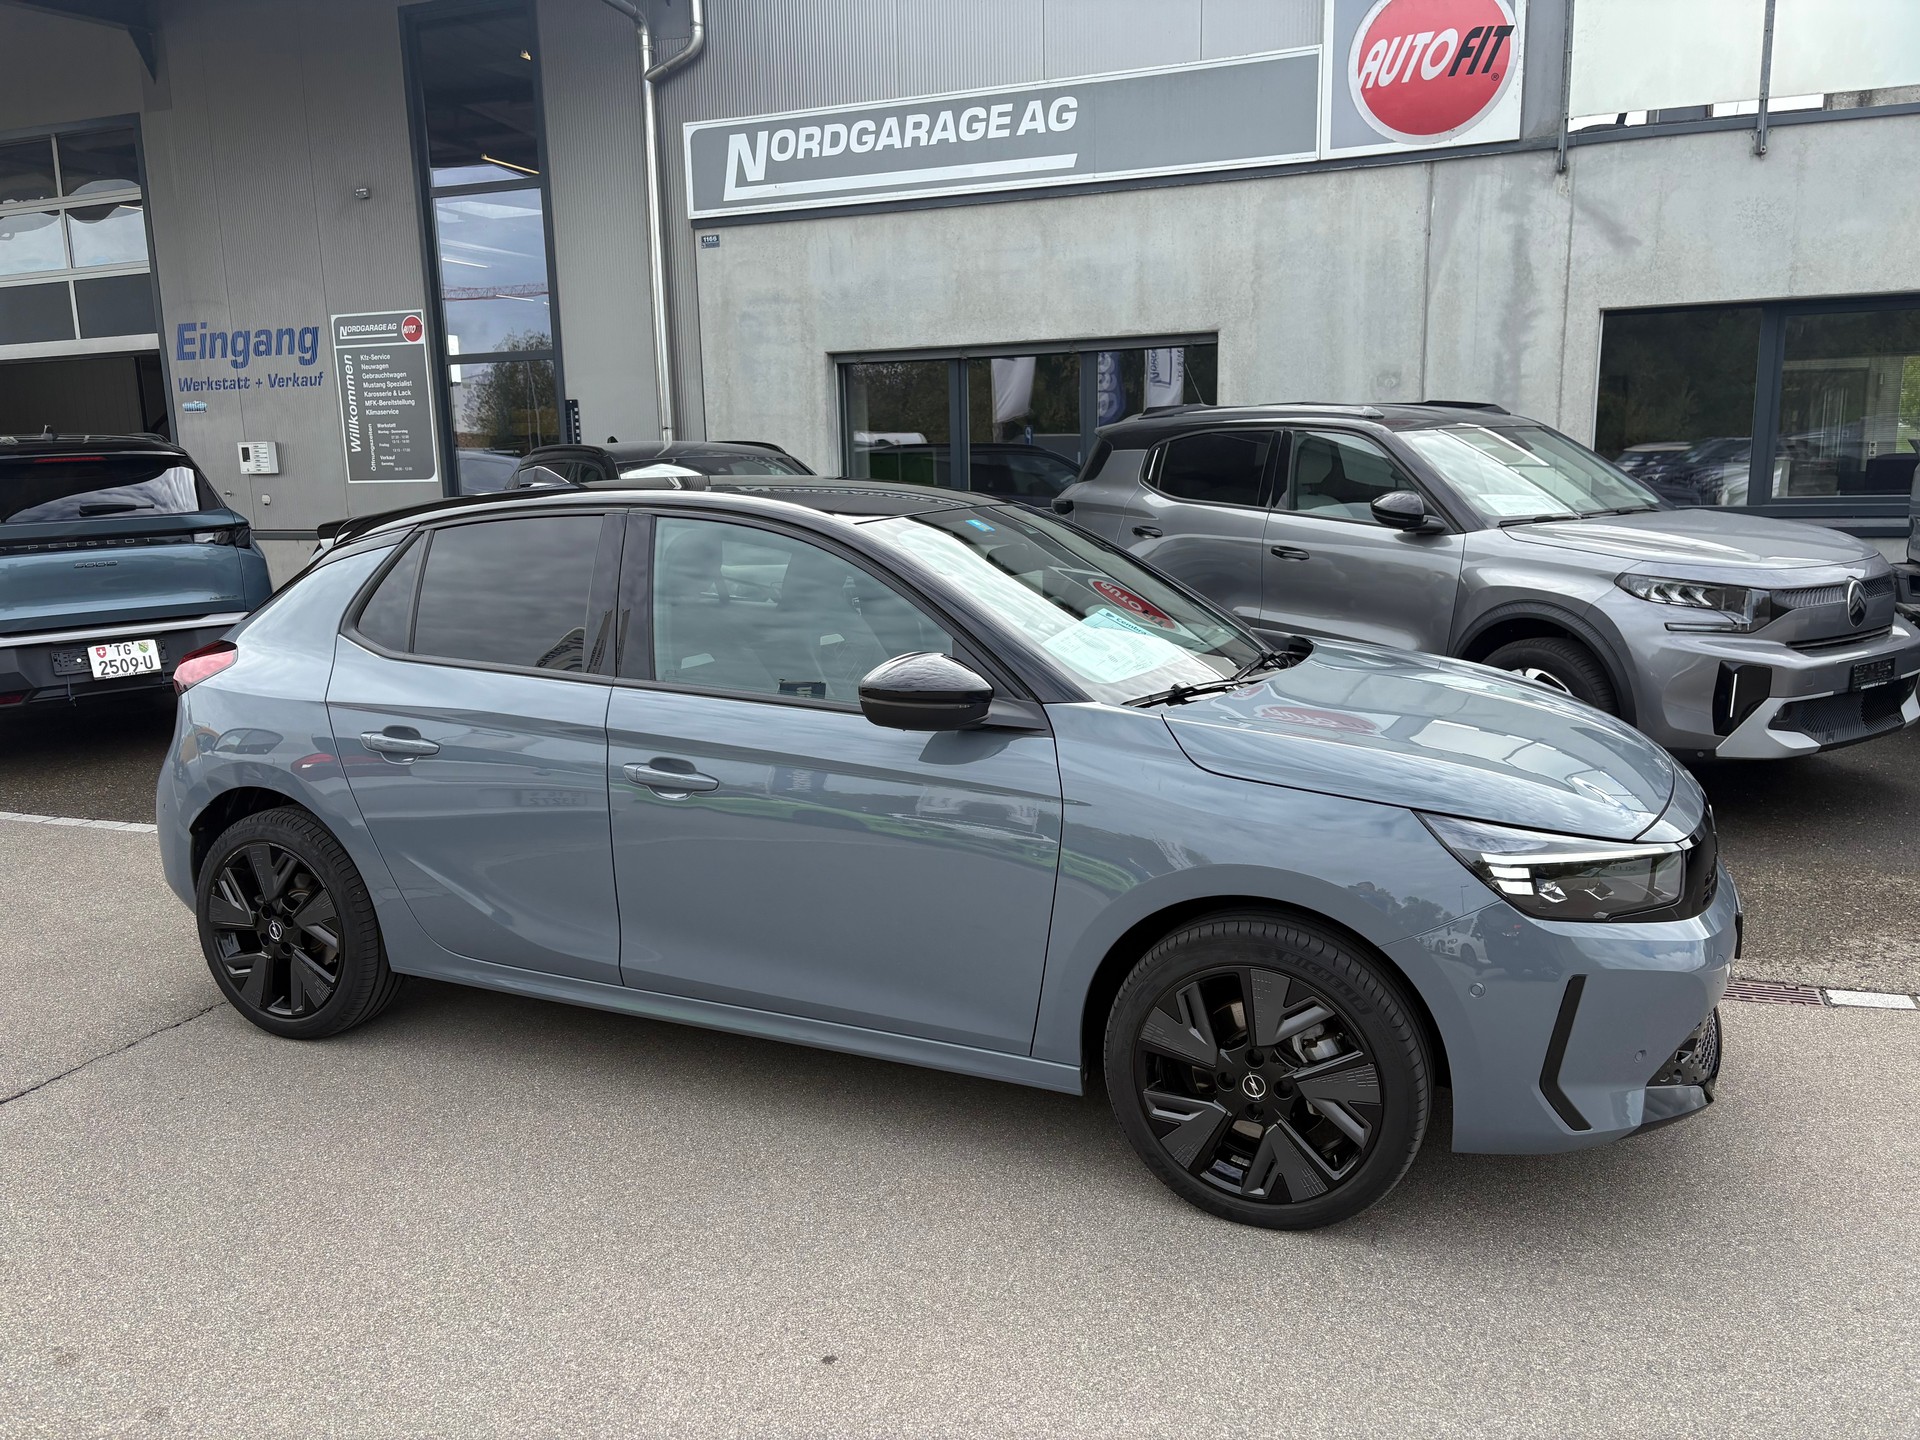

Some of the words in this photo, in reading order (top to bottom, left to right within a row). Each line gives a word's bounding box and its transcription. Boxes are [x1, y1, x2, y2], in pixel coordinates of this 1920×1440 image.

[1358, 25, 1515, 89] AUTOFIT
[724, 102, 1013, 201] NORDGARAGE
[1016, 97, 1078, 135] AG
[176, 322, 319, 369] Eingang
[340, 323, 387, 339] NORDGARAGE
[178, 376, 250, 392] Werkstatt
[255, 378, 263, 388] +
[268, 371, 324, 388] Verkauf
[386, 380, 412, 388] Spezialist
[344, 354, 361, 453] Willkommen
[368, 423, 376, 471] Öffnungszeiten
[27, 537, 152, 550] PEUGEOT
[114, 644, 132, 656] TG
